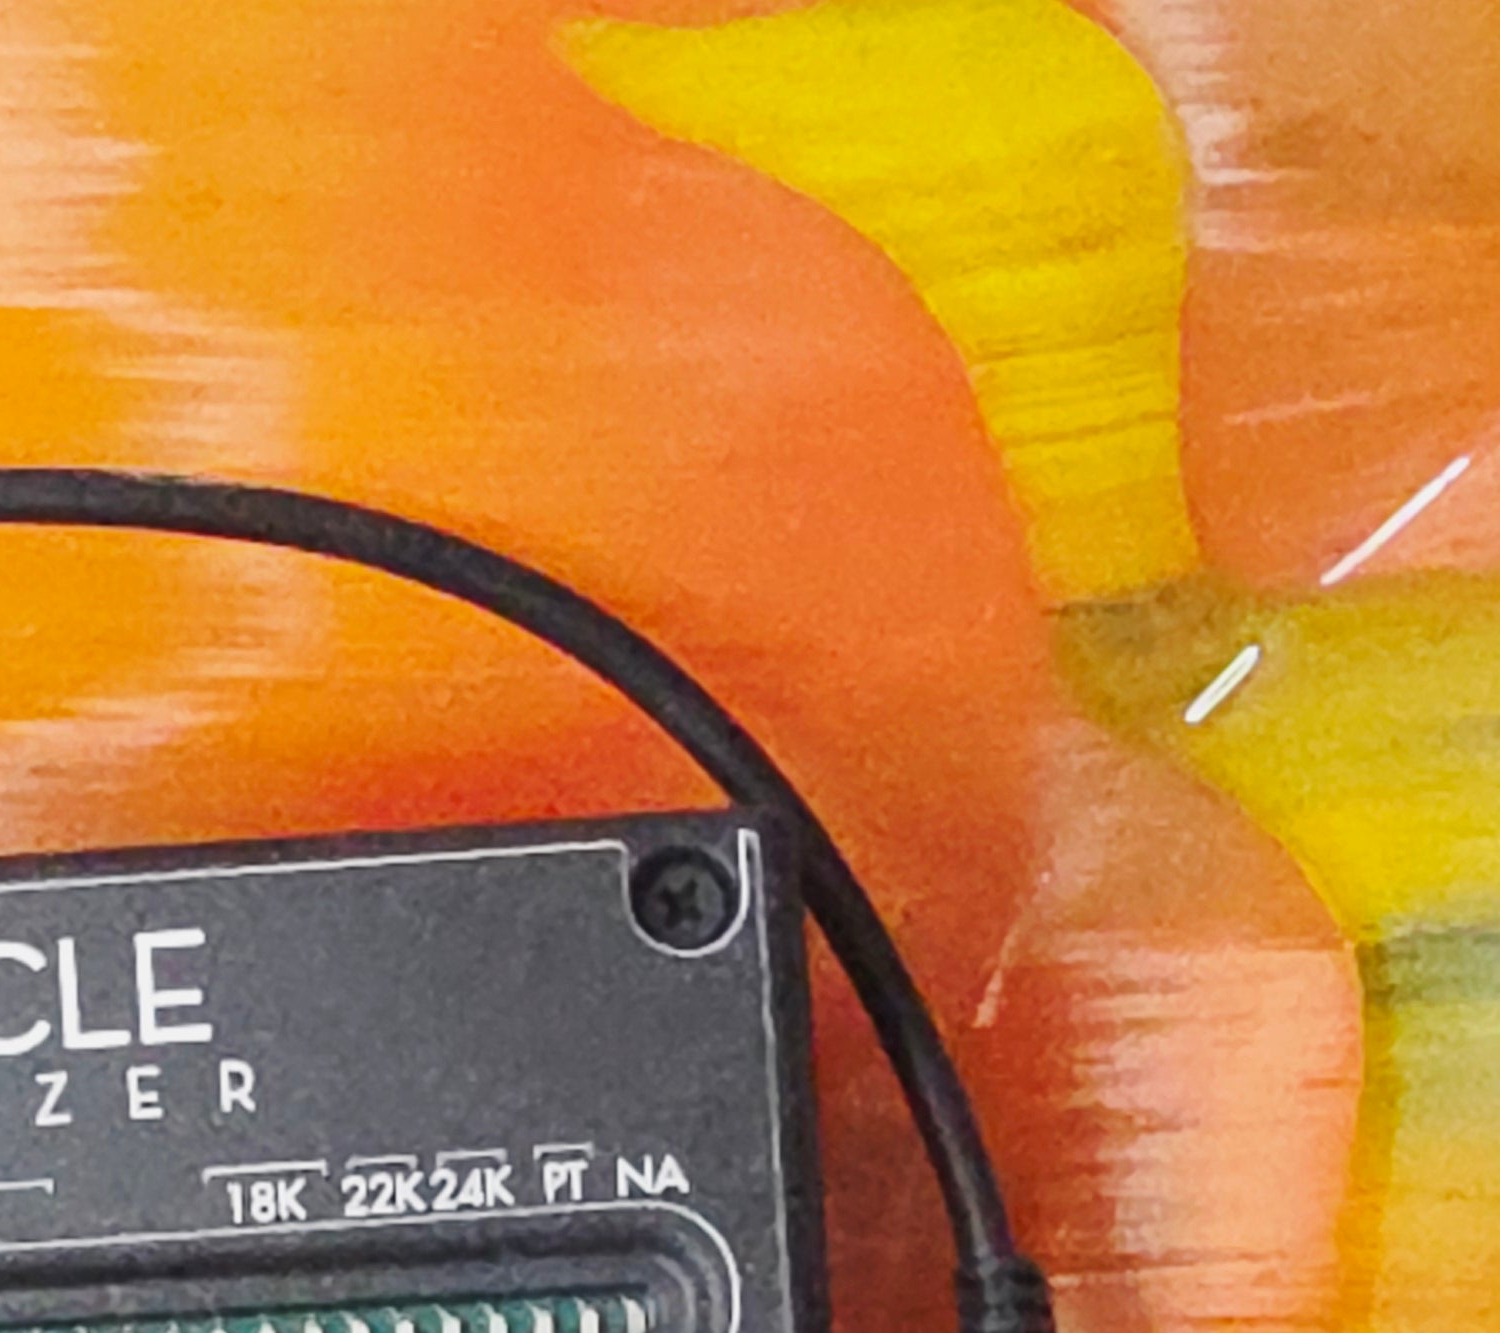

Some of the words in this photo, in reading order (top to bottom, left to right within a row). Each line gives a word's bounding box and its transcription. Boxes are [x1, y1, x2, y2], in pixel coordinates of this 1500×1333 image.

[226, 1177, 308, 1225] 18K
[341, 1170, 429, 1217] 22K
[430, 1165, 515, 1211] 24K
[542, 1159, 590, 1203] PT
[616, 1154, 690, 1197] NA
